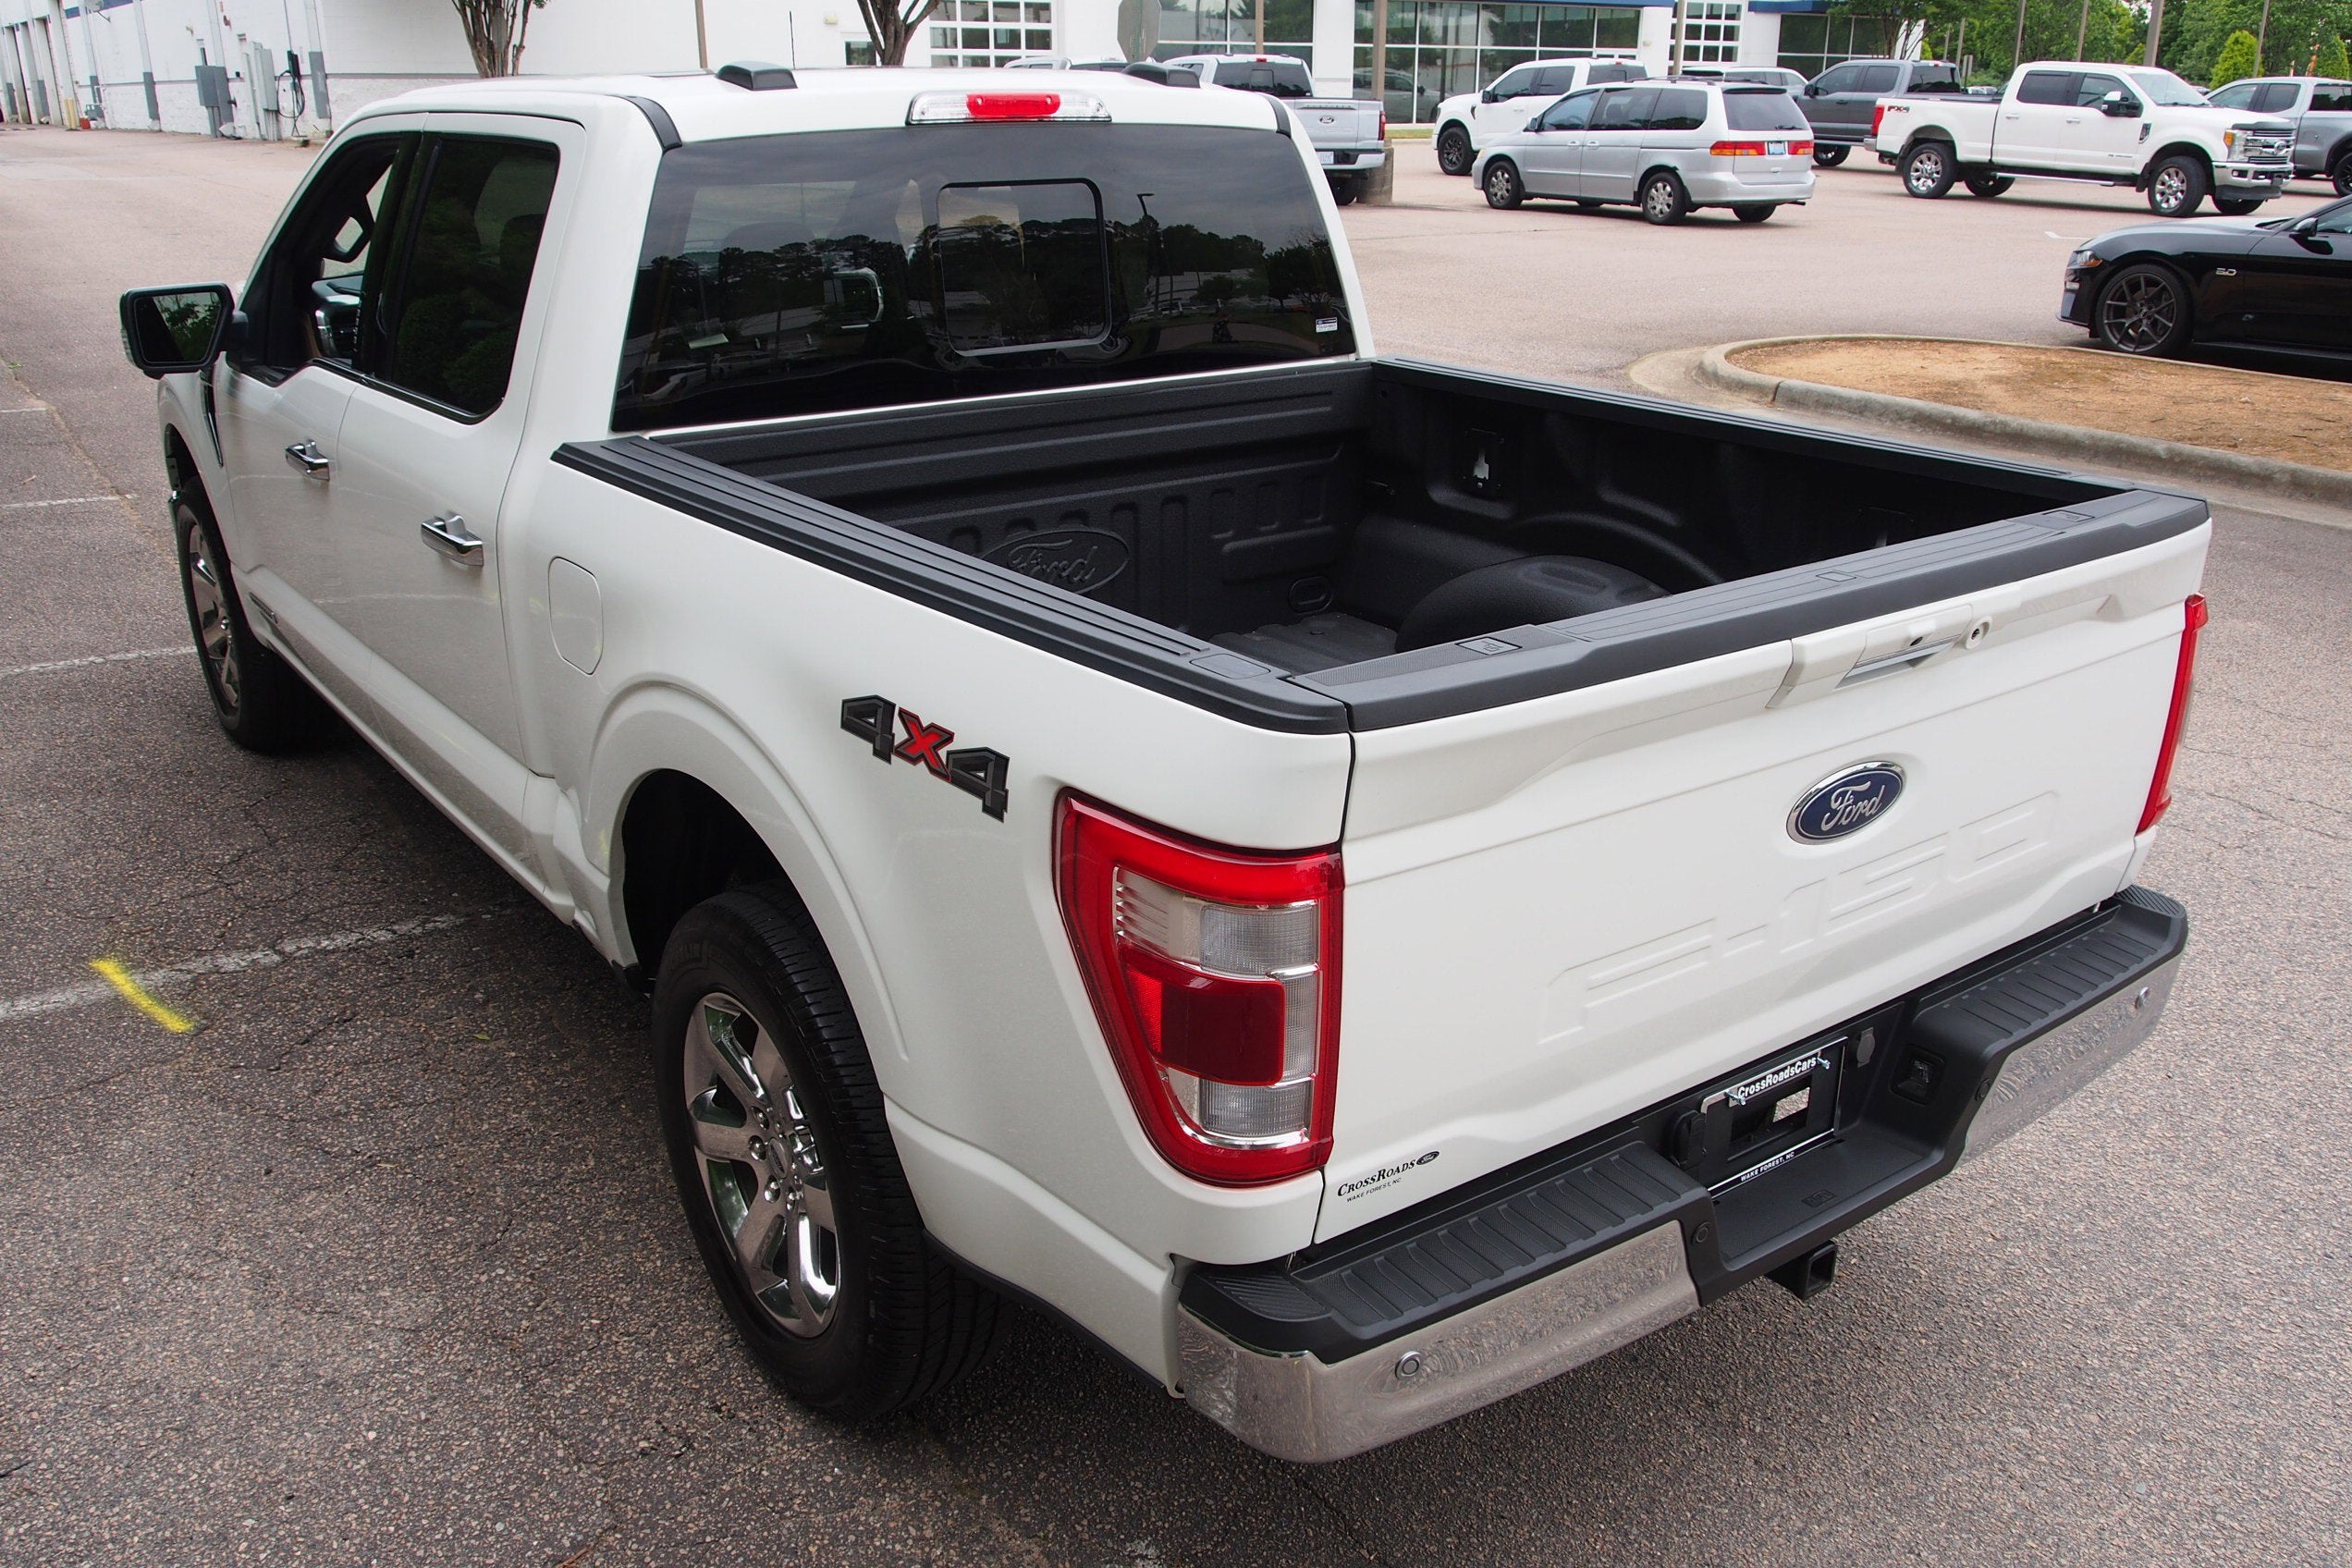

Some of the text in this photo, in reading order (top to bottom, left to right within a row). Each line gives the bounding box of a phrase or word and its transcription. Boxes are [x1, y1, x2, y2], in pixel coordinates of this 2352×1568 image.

[1820, 780, 1886, 832] Ford
[1738, 1057, 1817, 1098] CrossRoadsCars
[1740, 1169, 1759, 1182] WAKE
[1785, 1151, 1795, 1160] NC
[1347, 1190, 1365, 1203] WAKE
[1392, 1177, 1402, 1185] NC
